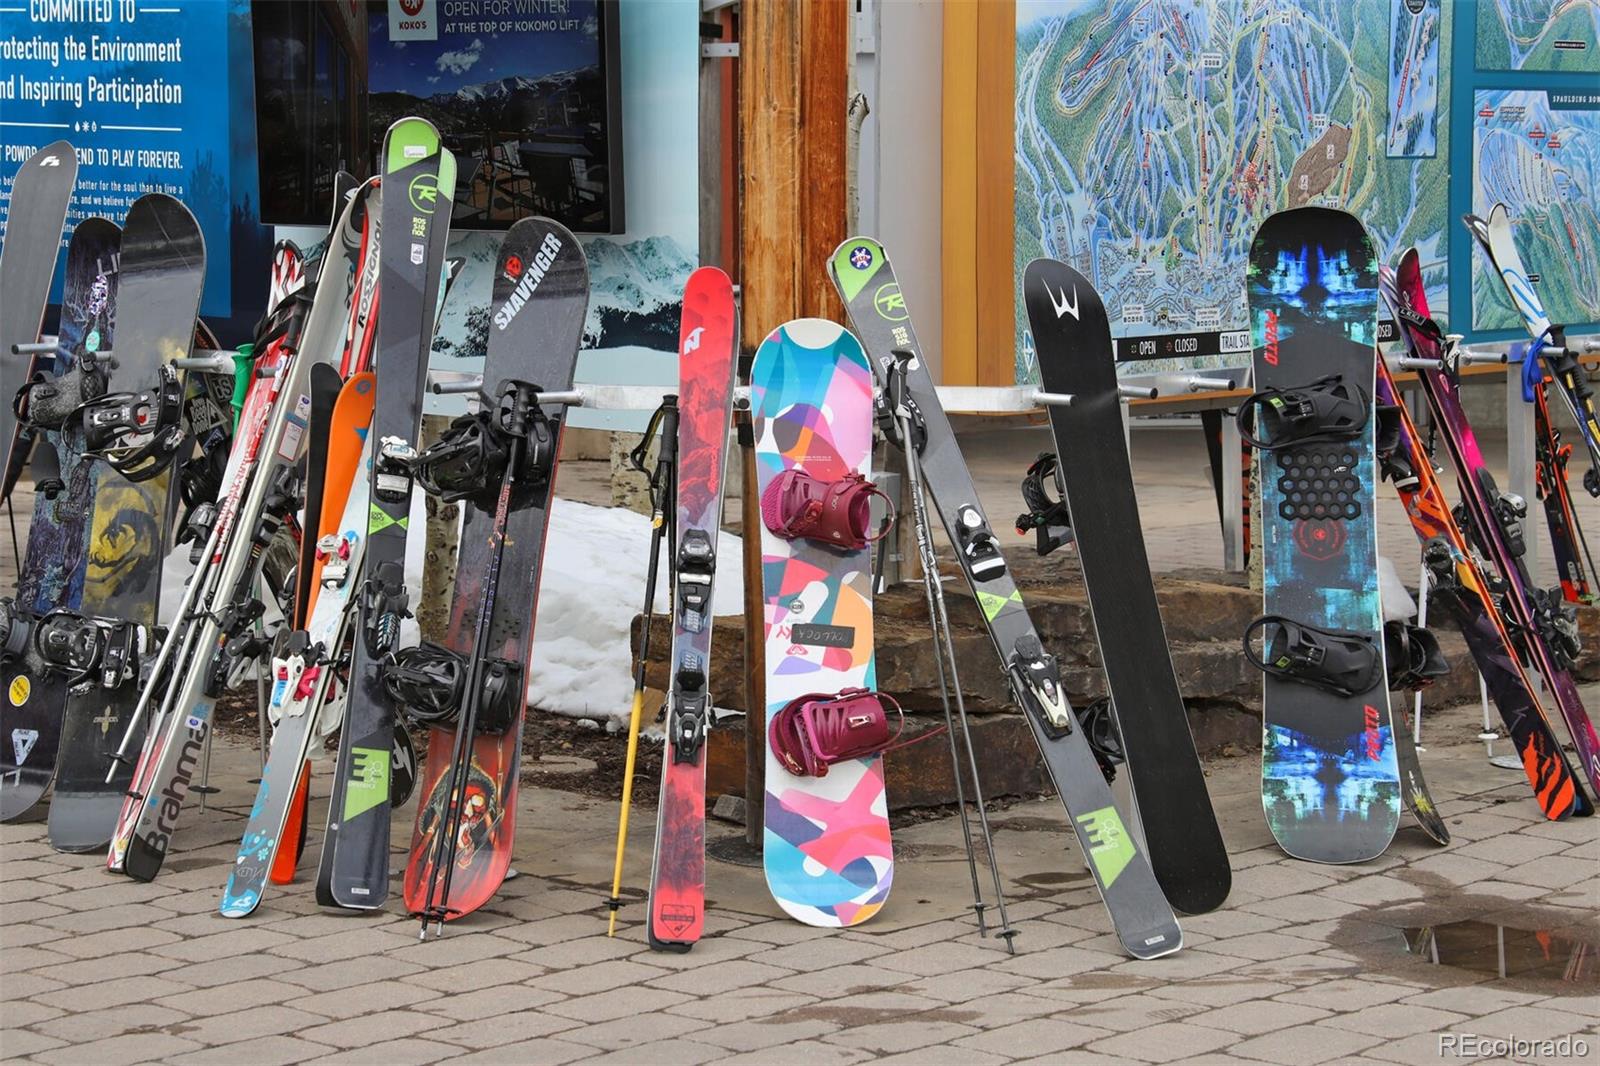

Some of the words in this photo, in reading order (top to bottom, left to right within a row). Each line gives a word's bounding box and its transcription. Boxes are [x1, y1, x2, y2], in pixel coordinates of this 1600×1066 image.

[30, 0, 112, 23] COMMITTED
[118, 0, 136, 23] TO
[444, 2, 479, 17] OPEN
[483, 0, 509, 16] FOR
[514, 0, 570, 15] WINTER!
[398, 21, 428, 31] KOKO'S
[444, 23, 457, 33] AT
[458, 22, 477, 33] THE
[478, 22, 497, 33] TOP
[499, 22, 513, 32] OF
[515, 20, 557, 32] KOKOMO
[559, 19, 580, 31] LIFT
[0, 36, 59, 67] rotecting
[64, 37, 86, 61] the
[92, 36, 182, 62] Environment
[0, 74, 15, 100] nd
[20, 75, 82, 108] Inspiring
[88, 77, 182, 110] Participation
[97, 149, 109, 167] TO
[112, 150, 135, 168] PLAY
[138, 150, 183, 170] FOREVER.
[78, 180, 97, 191] better
[99, 181, 109, 191] for
[111, 182, 121, 192] the
[123, 183, 137, 193] soul
[139, 183, 153, 194] than
[155, 184, 162, 194] to
[164, 184, 177, 194] live
[81, 196, 92, 206] and
[94, 199, 102, 207] we
[103, 197, 124, 208] believe
[1139, 340, 1157, 356] OPEN
[1174, 337, 1198, 353] CLOSED
[1221, 335, 1239, 350] TRAIL
[146, 721, 208, 859] Brahma
